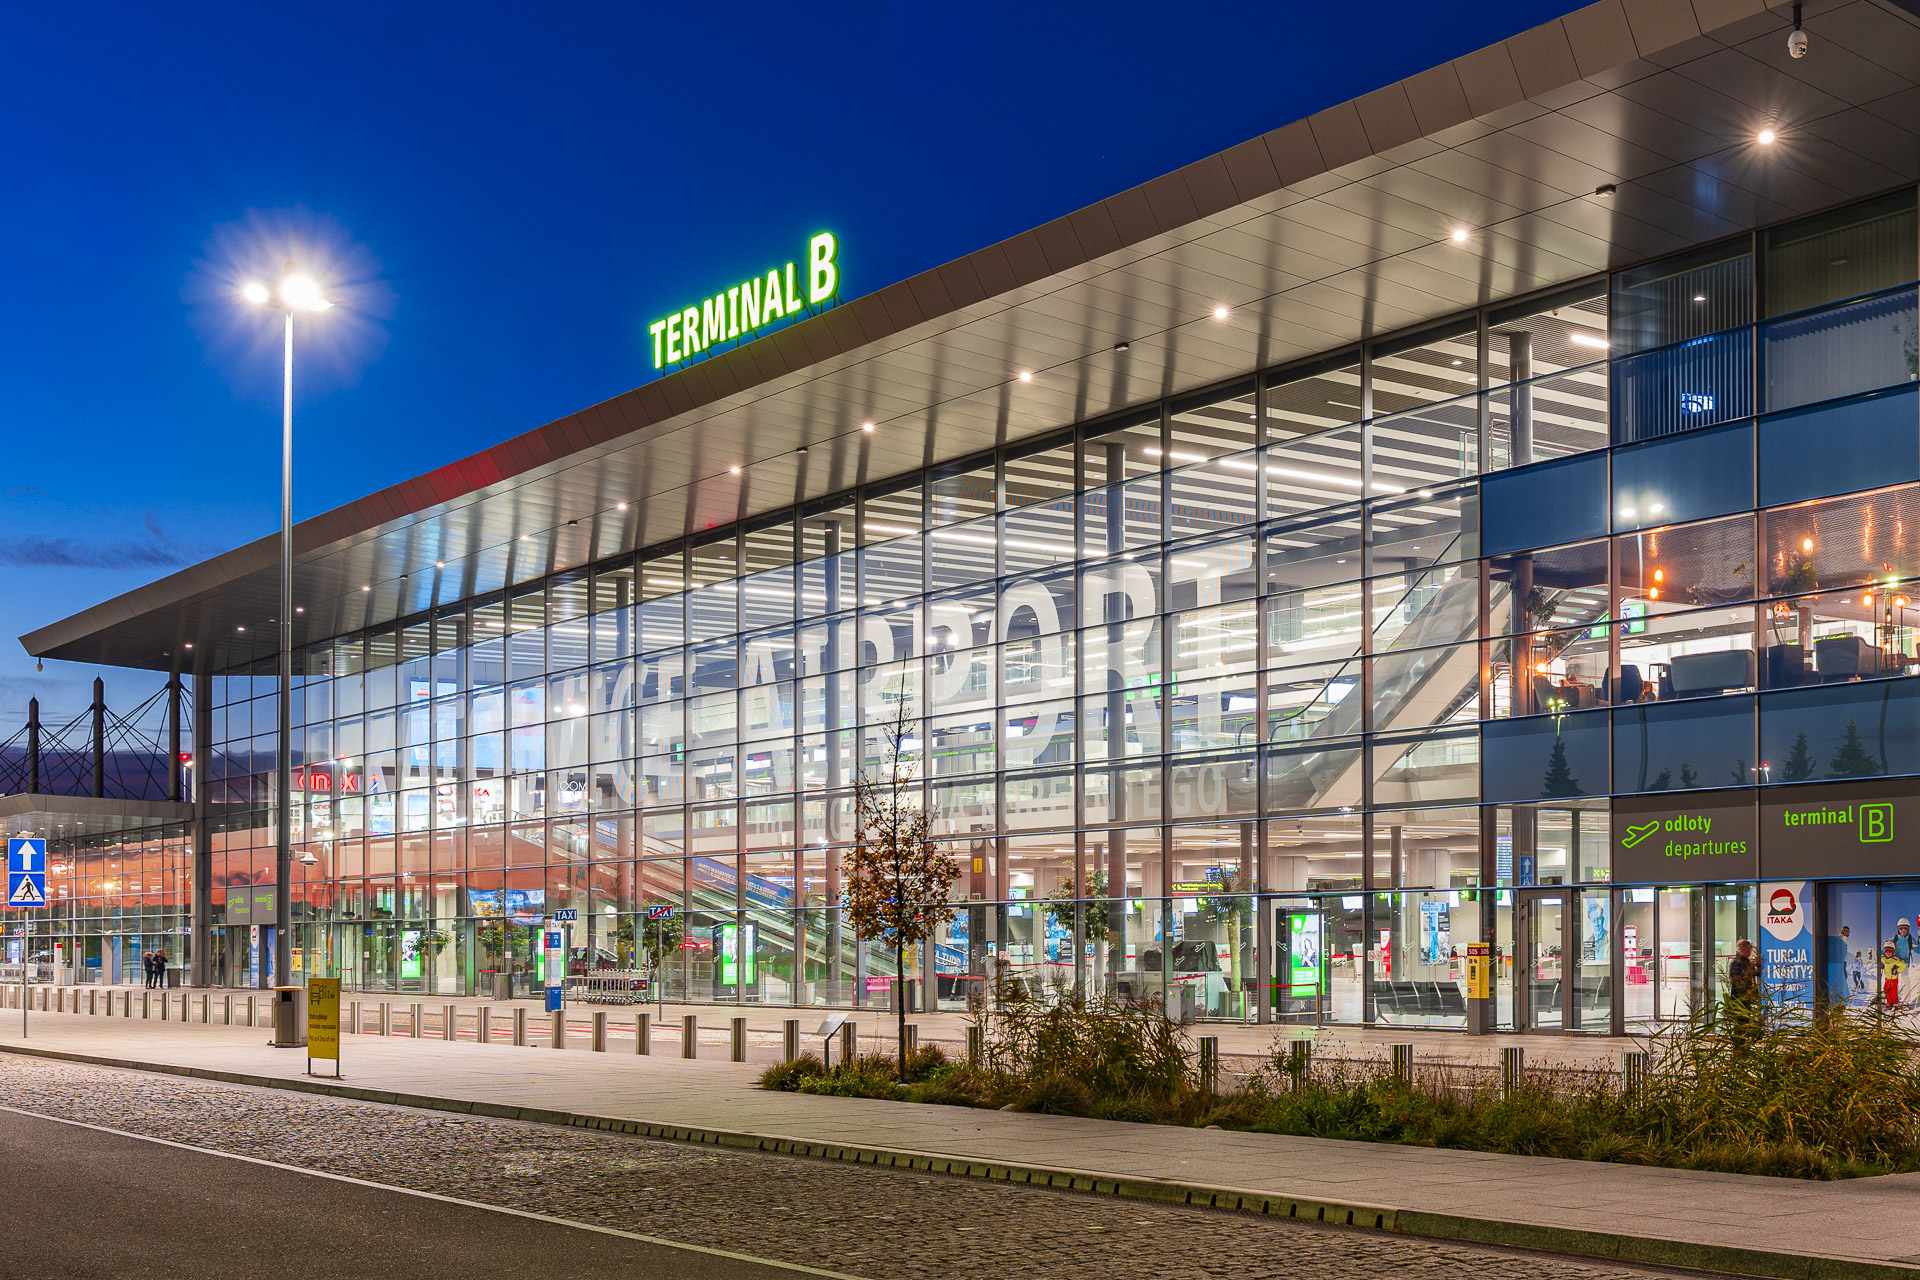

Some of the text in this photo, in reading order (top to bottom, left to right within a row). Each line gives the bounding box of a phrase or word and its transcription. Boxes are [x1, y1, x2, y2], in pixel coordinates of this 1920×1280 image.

[650, 232, 840, 369] TERMINAL B
[731, 534, 1252, 787] AIRPORT
[298, 773, 356, 791] anx
[1665, 815, 1711, 834] odloty
[1784, 806, 1853, 826] terminal
[1868, 809, 1885, 837] B
[1665, 840, 1747, 859] departures
[556, 911, 576, 920] TAXI
[650, 907, 673, 917] TAXI
[1766, 949, 1808, 963] TURCJA
[1767, 965, 1813, 979] I NARTY?
